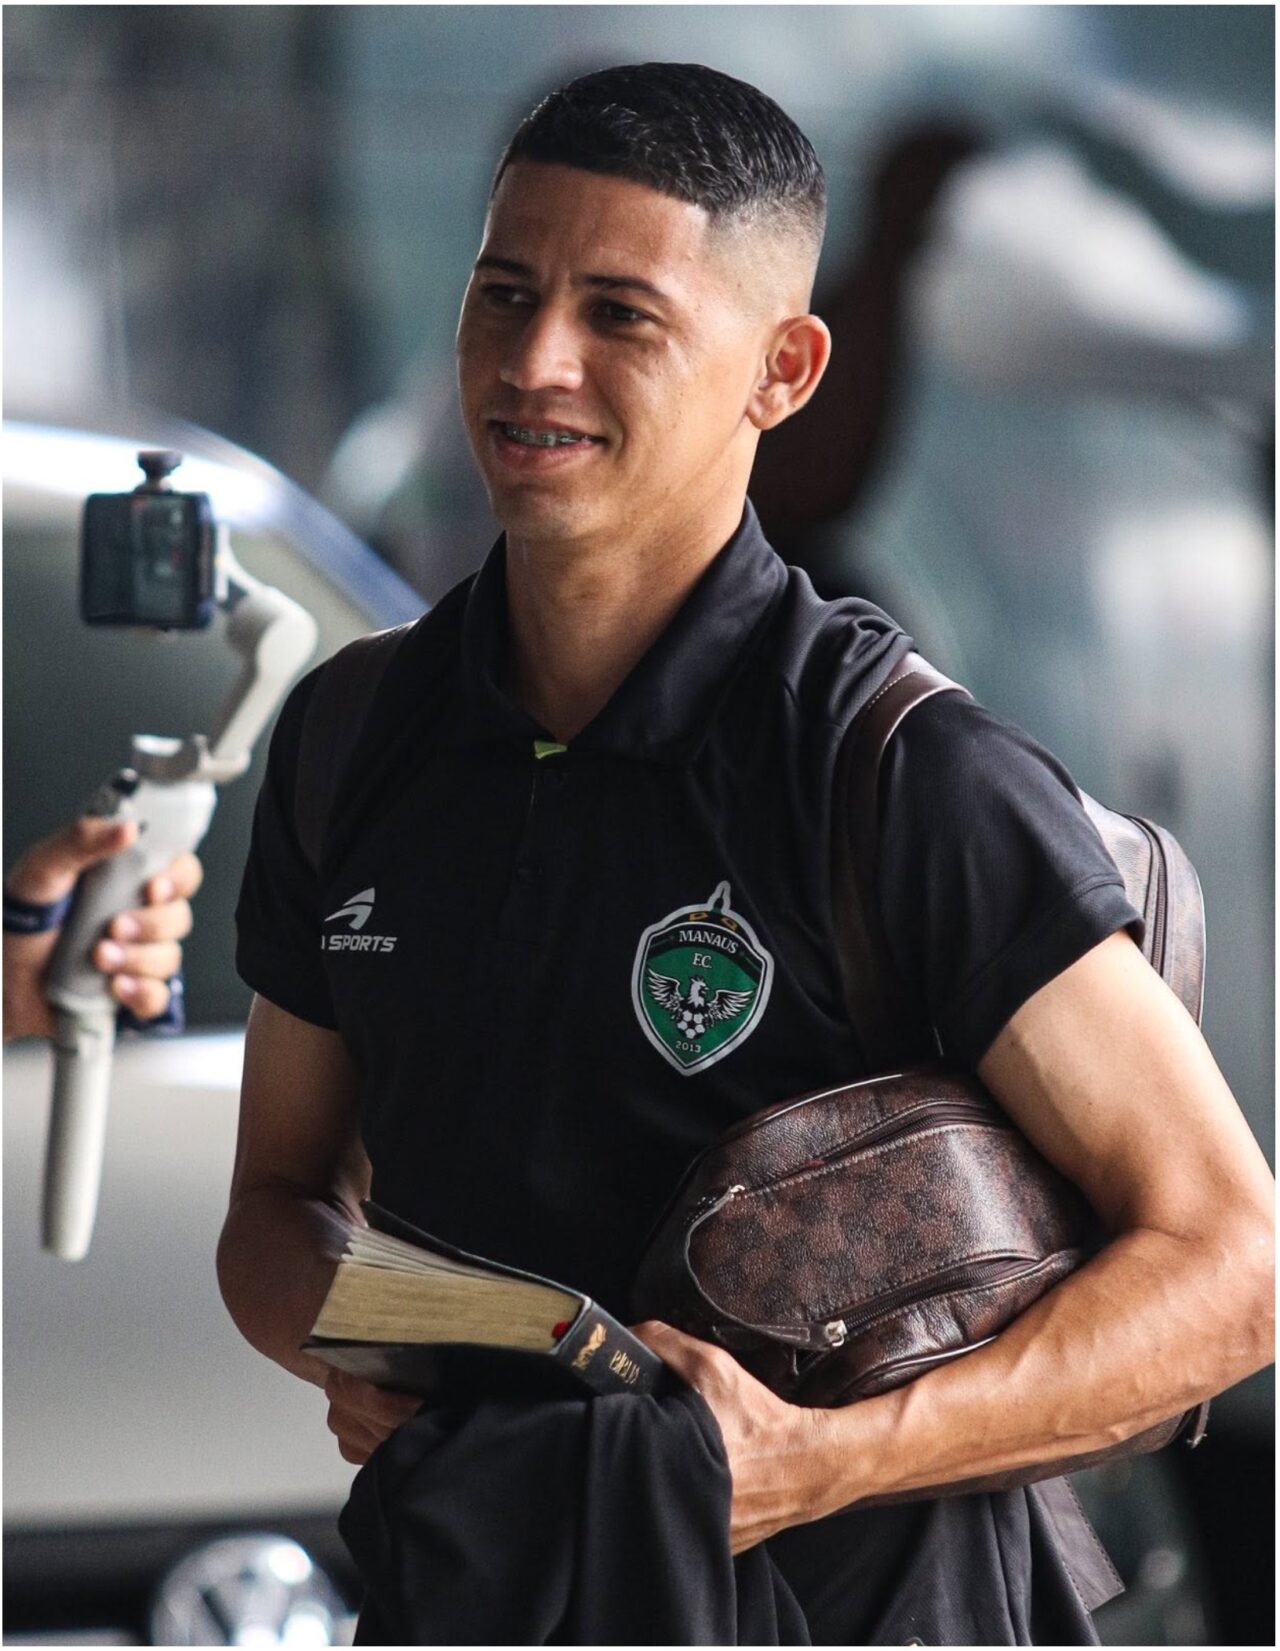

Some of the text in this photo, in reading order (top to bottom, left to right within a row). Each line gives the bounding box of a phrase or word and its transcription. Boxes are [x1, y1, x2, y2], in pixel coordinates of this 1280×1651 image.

[328, 934, 398, 952] SPORTS
[678, 929, 739, 954] MANAUS
[675, 1040, 702, 1053] 2013
